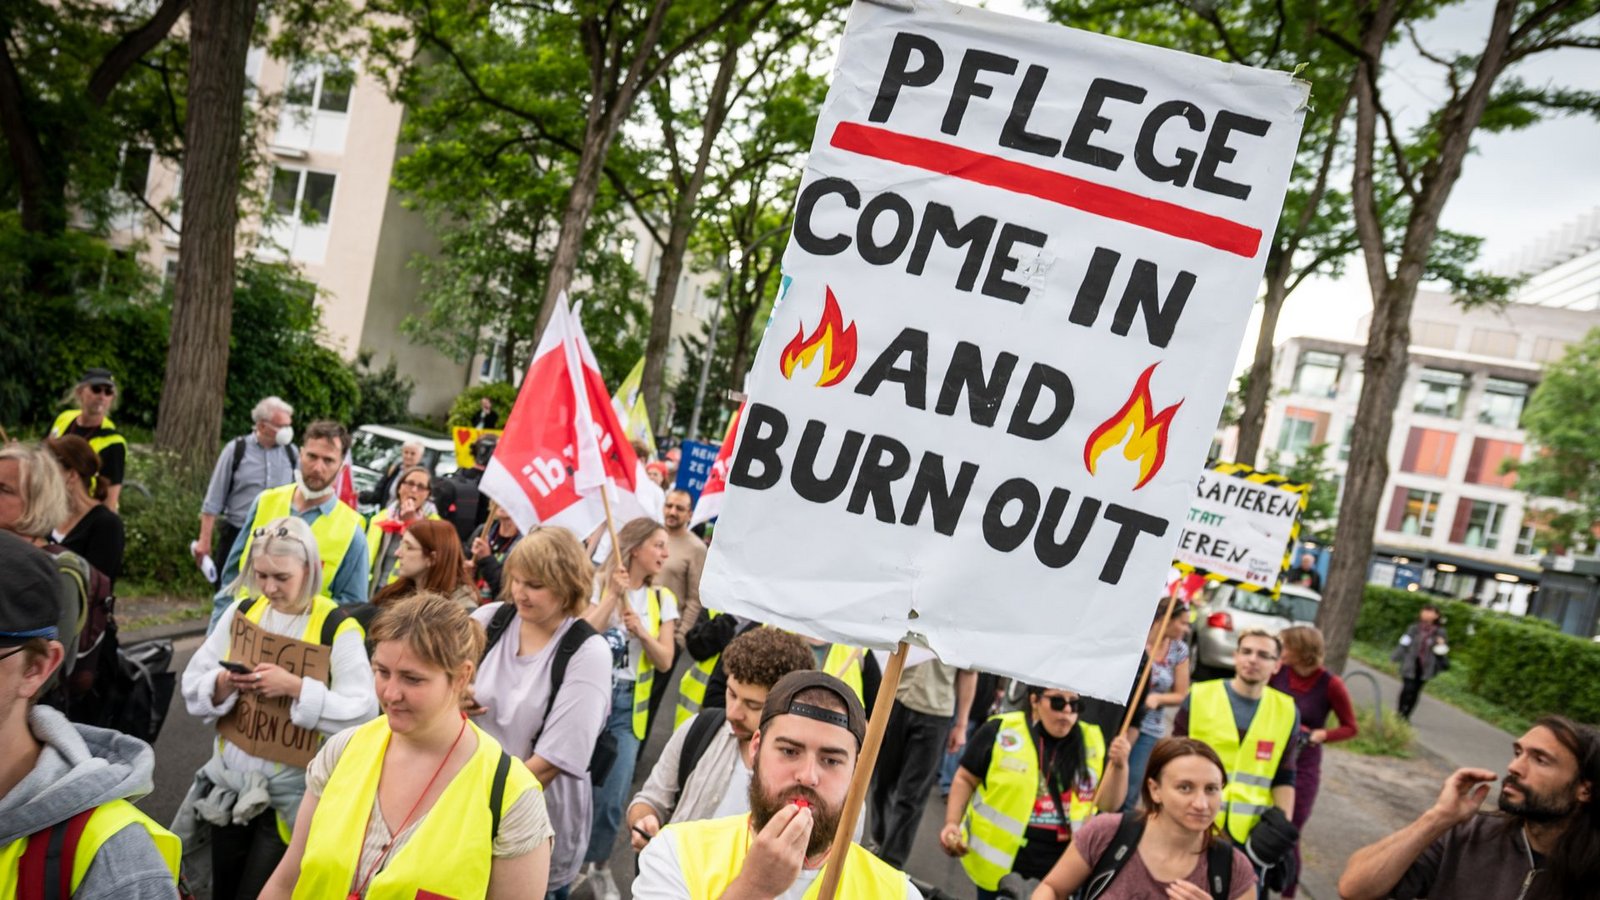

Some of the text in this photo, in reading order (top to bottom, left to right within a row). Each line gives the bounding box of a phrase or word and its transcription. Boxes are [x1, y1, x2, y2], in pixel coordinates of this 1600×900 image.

[868, 32, 1272, 201] PFLEGE
[793, 176, 1197, 349] COME IN
[854, 327, 1075, 441] AND
[729, 402, 1169, 585] BURN OUT
[1186, 507, 1227, 528] TATT
[235, 702, 279, 742] BURN
